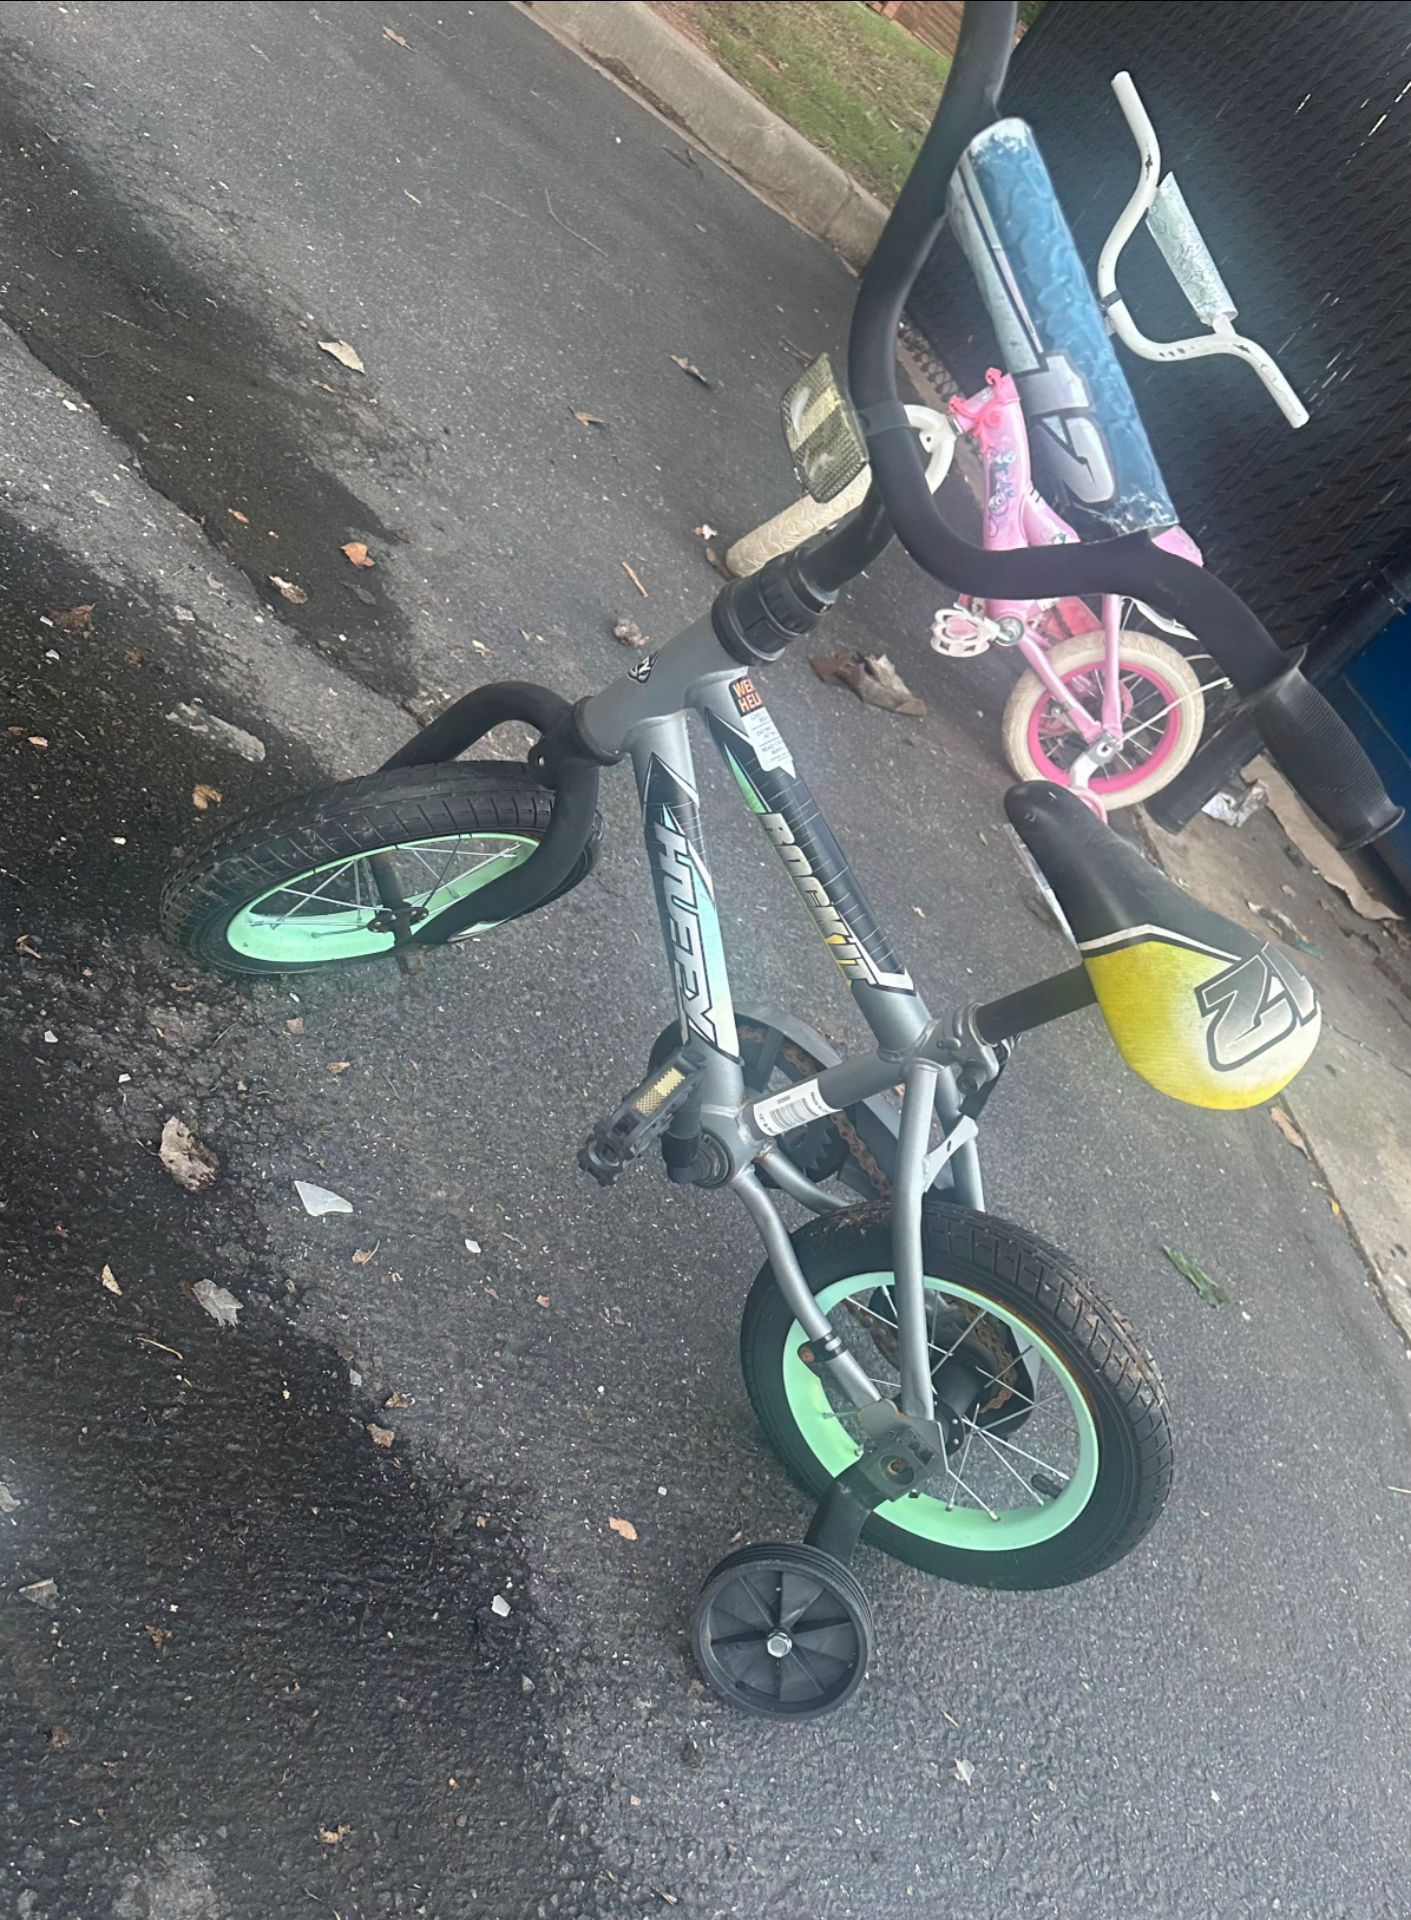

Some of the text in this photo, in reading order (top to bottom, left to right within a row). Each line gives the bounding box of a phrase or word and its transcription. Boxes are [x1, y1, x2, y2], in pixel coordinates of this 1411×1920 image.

[1018, 354, 1117, 504] 12
[655, 822, 718, 1047] HUFFY
[757, 812, 877, 986] ROCK IT
[1196, 943, 1317, 1071] 12
